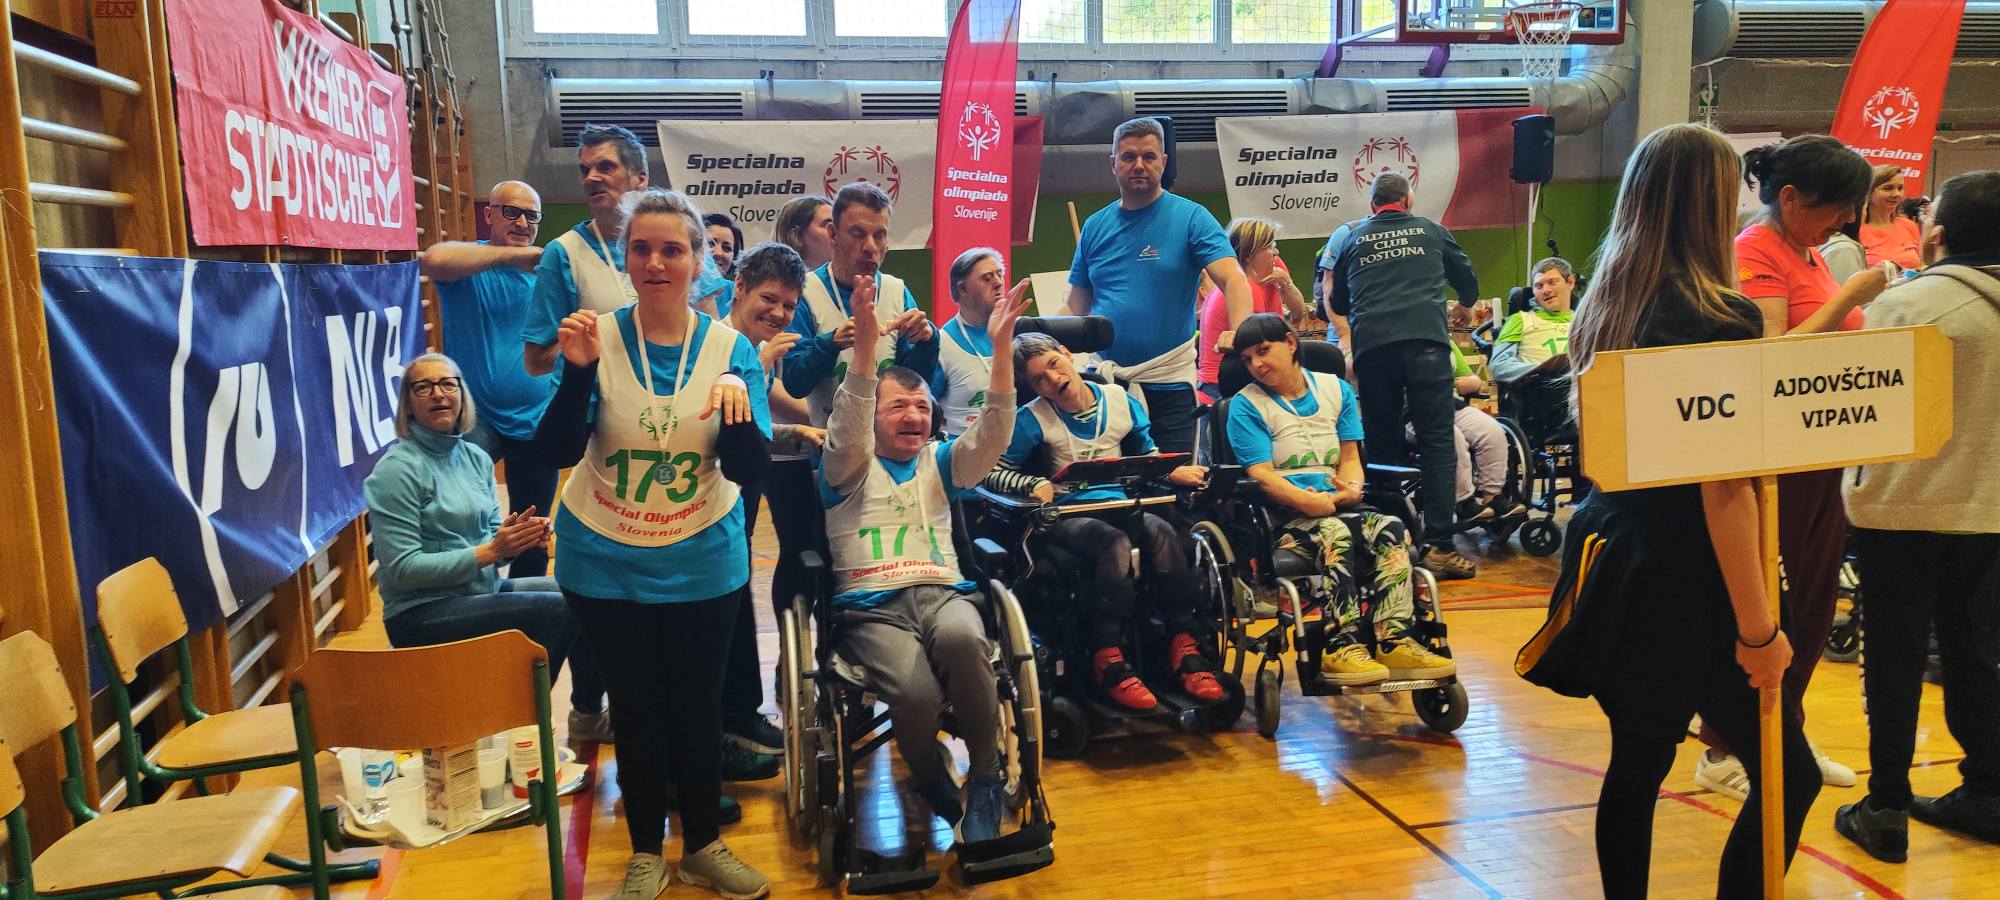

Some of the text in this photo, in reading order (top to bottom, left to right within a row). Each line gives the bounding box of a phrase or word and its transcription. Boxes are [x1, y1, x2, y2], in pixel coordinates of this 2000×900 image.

[274, 19, 369, 142] WIENER
[686, 154, 805, 173] Specialna
[1238, 146, 1338, 165] Specialna
[947, 167, 1008, 183] Specialna
[1235, 170, 1339, 188] olimpiada
[685, 180, 806, 198] olimpiada
[943, 186, 1009, 202] olimpiada
[1270, 193, 1340, 211] Slovenije
[729, 205, 781, 222] Slove
[954, 205, 998, 221] Slovenije
[1356, 228, 1426, 245] OLDTIMER
[1374, 238, 1409, 250] CLUB
[1360, 247, 1426, 266] POSTOJNA
[1773, 366, 1904, 397] AJDOVŠČINA
[1676, 393, 1736, 422] VDC
[1801, 405, 1878, 429] VIPAVA
[605, 449, 702, 503] 173
[617, 522, 682, 538] Slovenia
[882, 569, 940, 581] Slovenia
